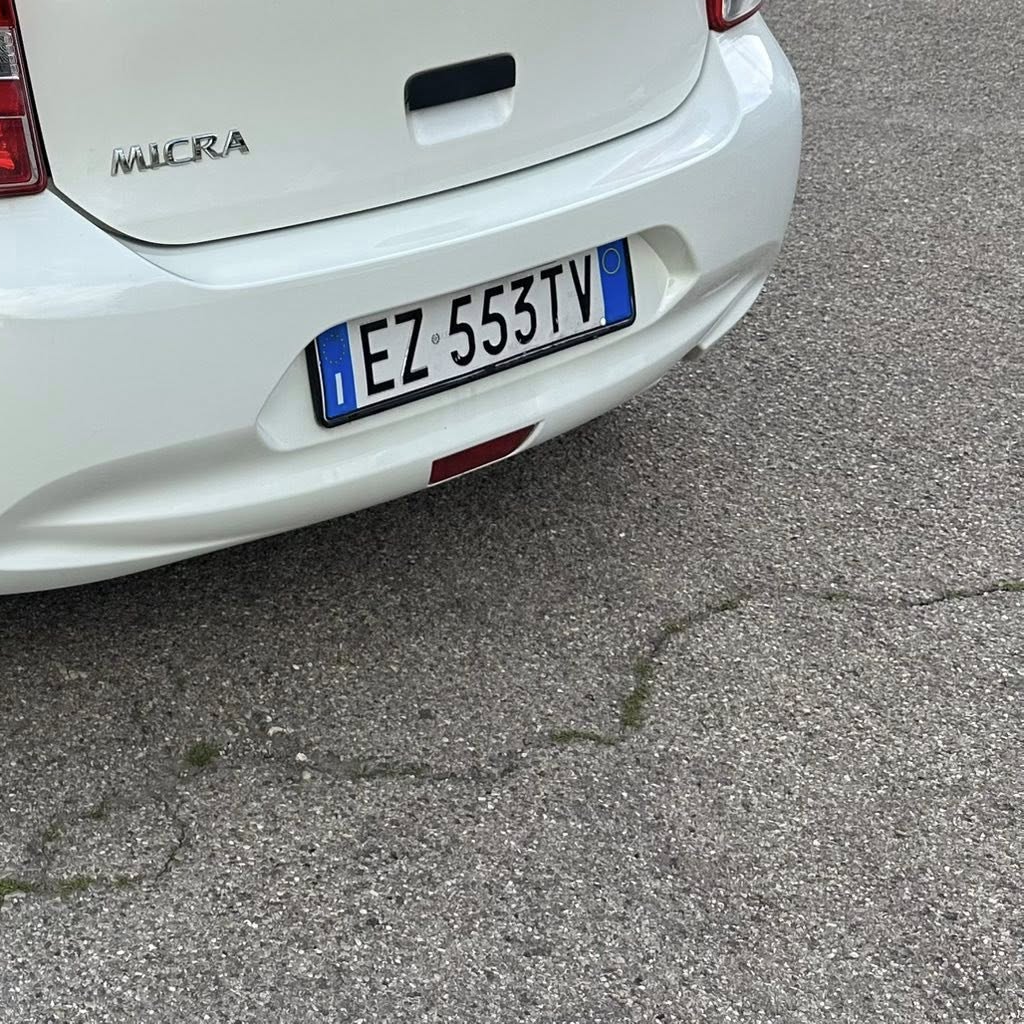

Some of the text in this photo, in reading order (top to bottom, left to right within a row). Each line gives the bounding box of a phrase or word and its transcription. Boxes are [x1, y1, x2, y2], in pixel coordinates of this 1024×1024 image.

[110, 128, 250, 177] MICRA
[359, 308, 429, 396] EZ
[448, 254, 592, 367] 553TV
